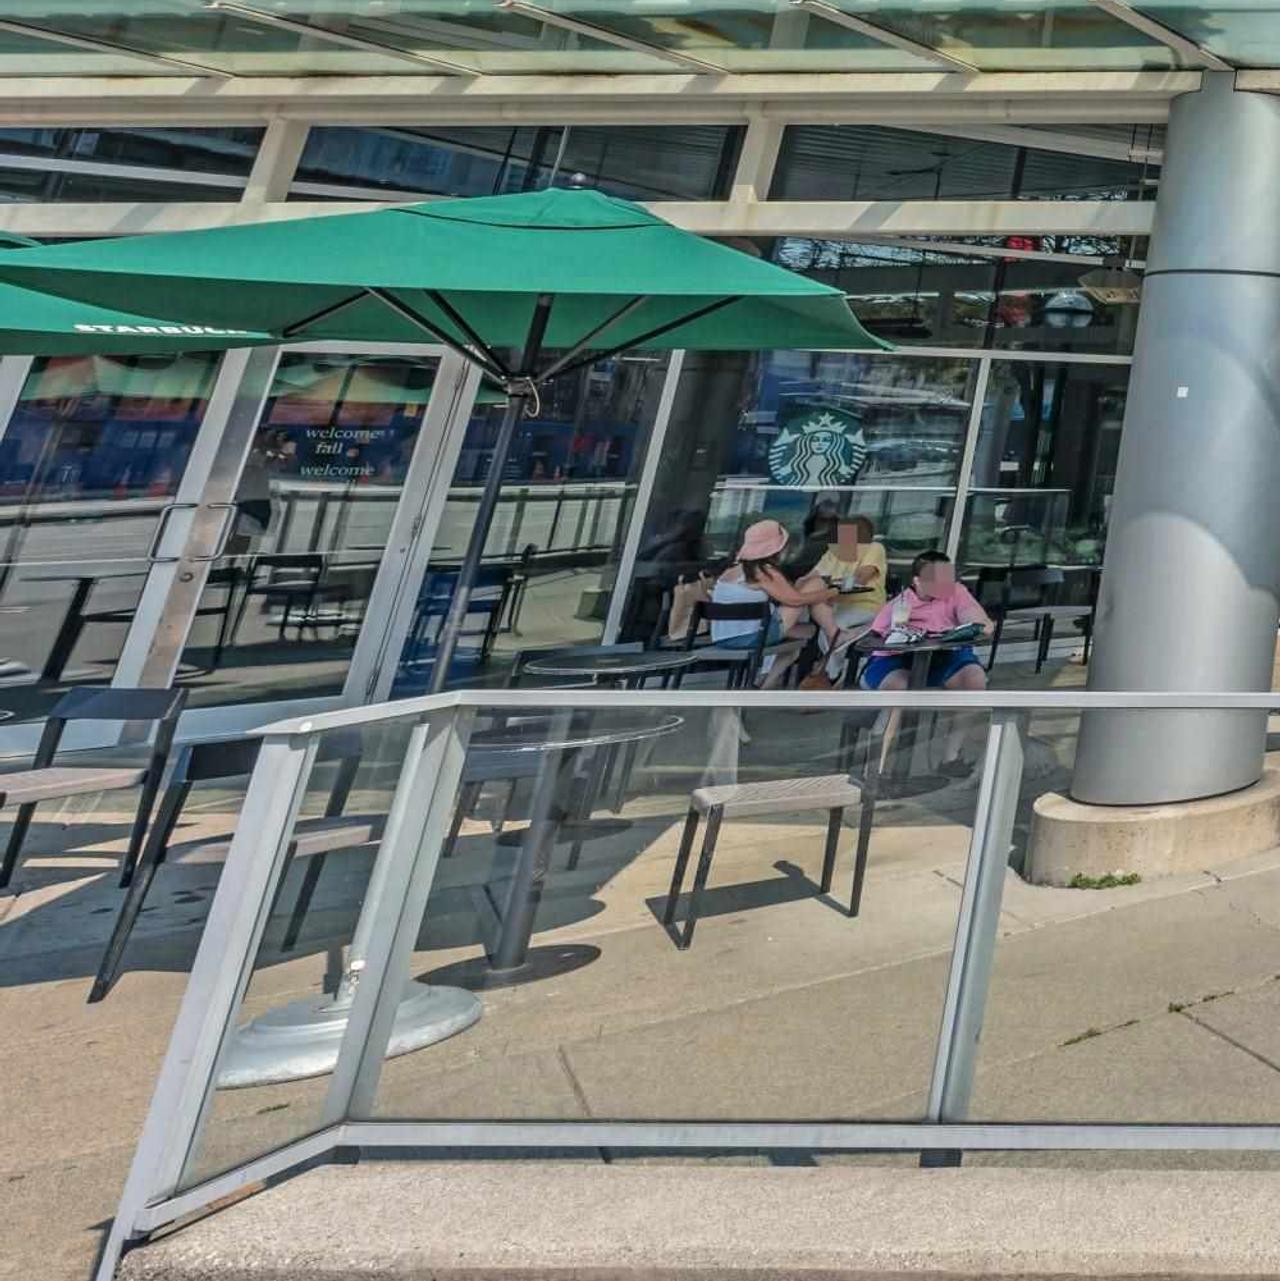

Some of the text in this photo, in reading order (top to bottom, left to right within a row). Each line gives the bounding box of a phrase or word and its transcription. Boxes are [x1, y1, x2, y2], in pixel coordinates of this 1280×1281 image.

[74, 323, 248, 335] STARBU
[306, 427, 381, 440] welcome
[301, 464, 376, 477] welcome
